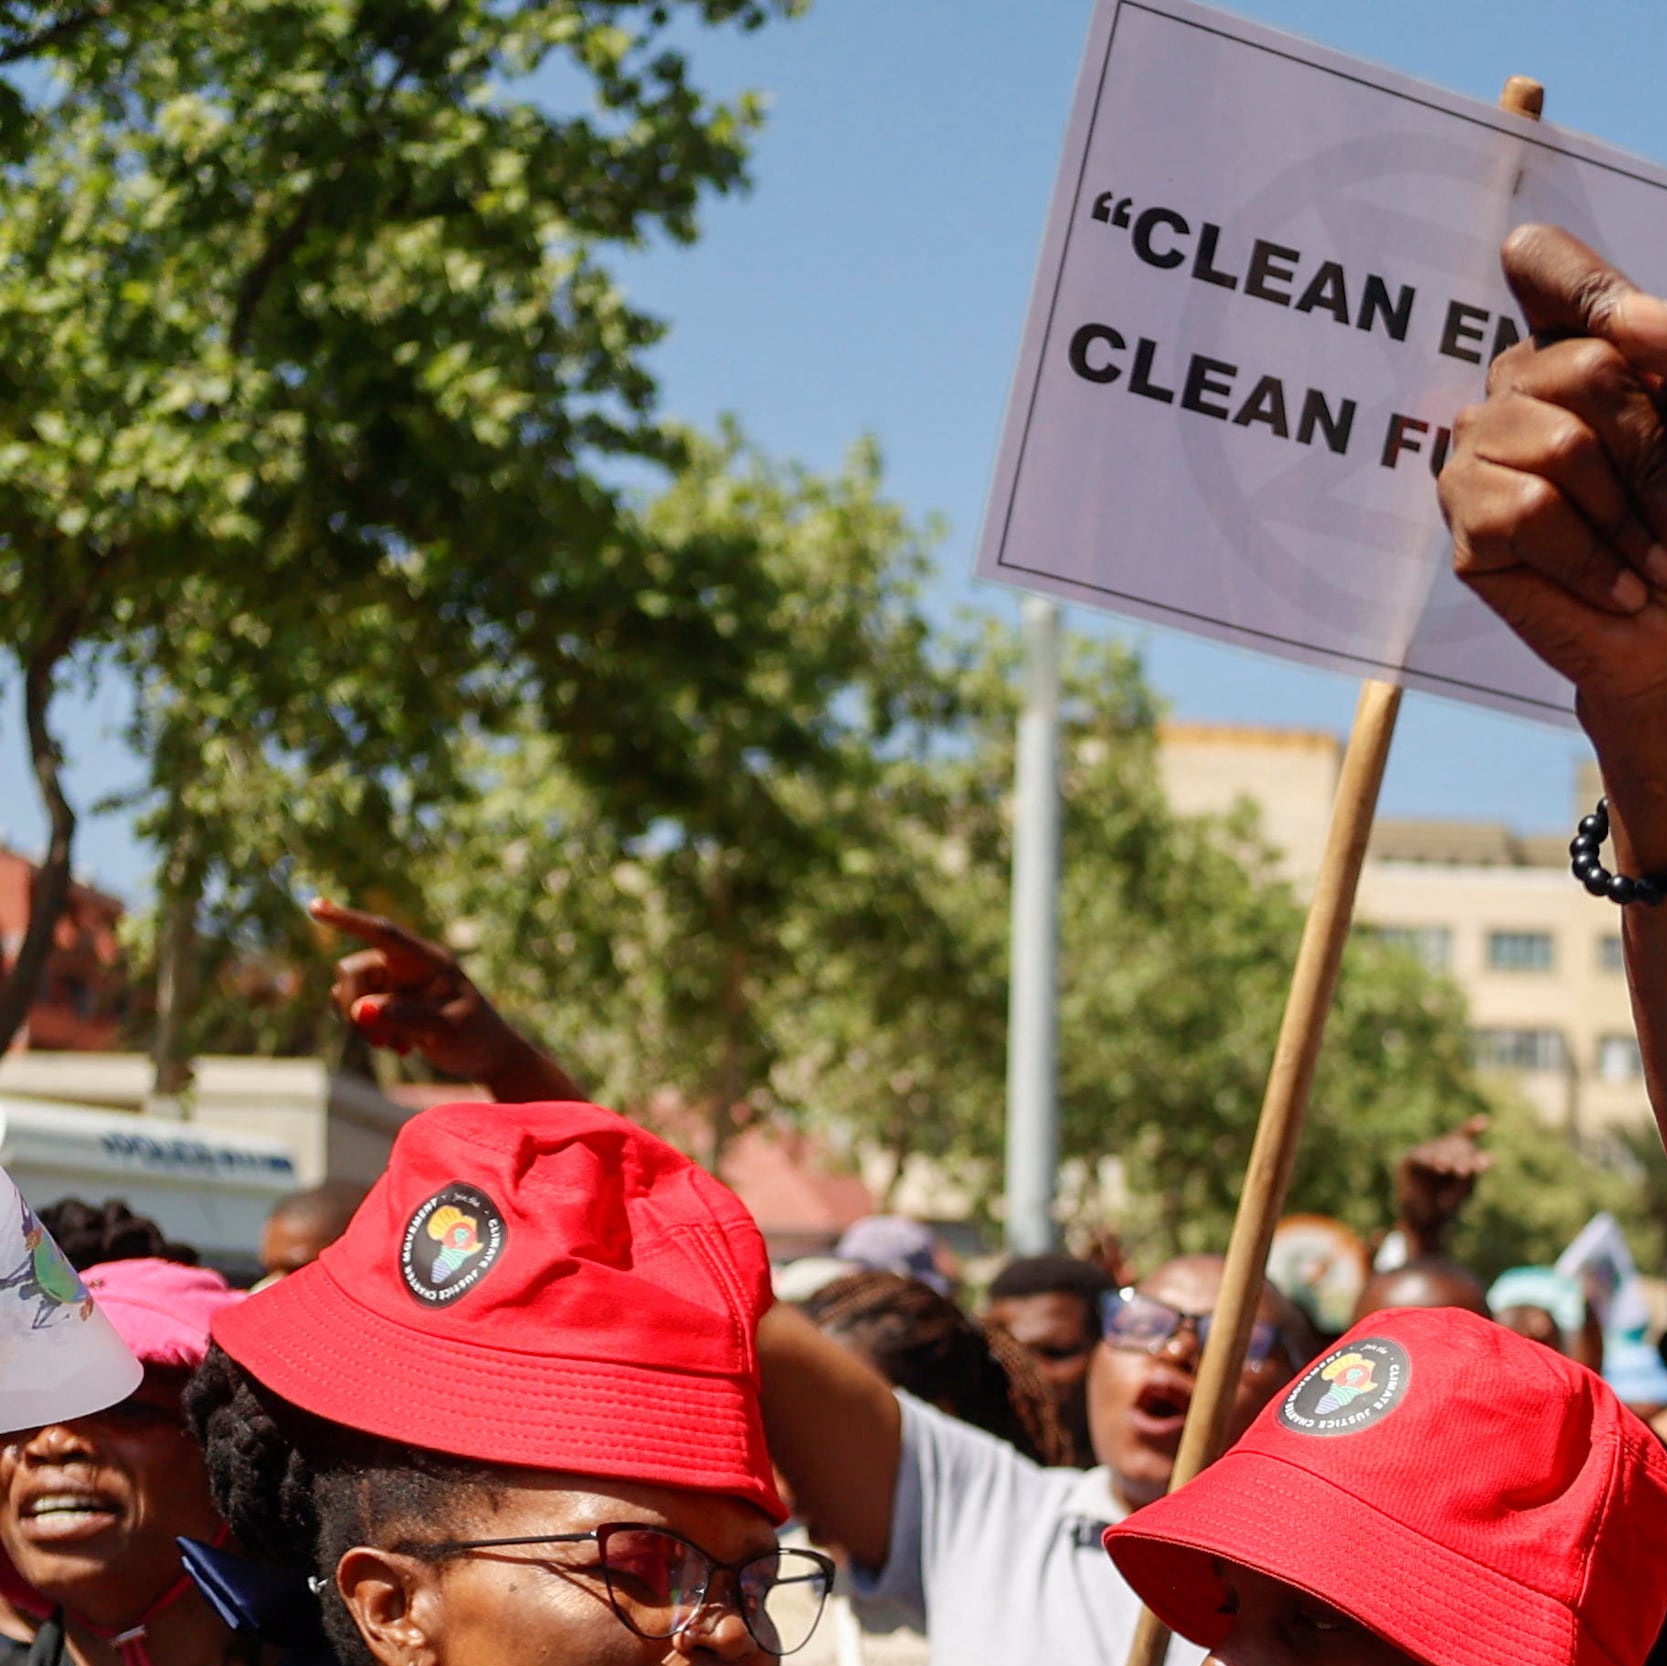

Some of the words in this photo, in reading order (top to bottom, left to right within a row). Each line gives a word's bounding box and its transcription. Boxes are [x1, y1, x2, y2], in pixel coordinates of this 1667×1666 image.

[1068, 322, 1357, 455] CLEAN
[402, 1197, 438, 1263] MOVEMENT
[479, 1218, 501, 1268] CLIMATE
[438, 1269, 478, 1300] JUSTICE
[1373, 1364, 1400, 1410] CLIMATE
[1284, 1402, 1315, 1428] CHARTER
[1318, 1408, 1371, 1429] JUSTICE
